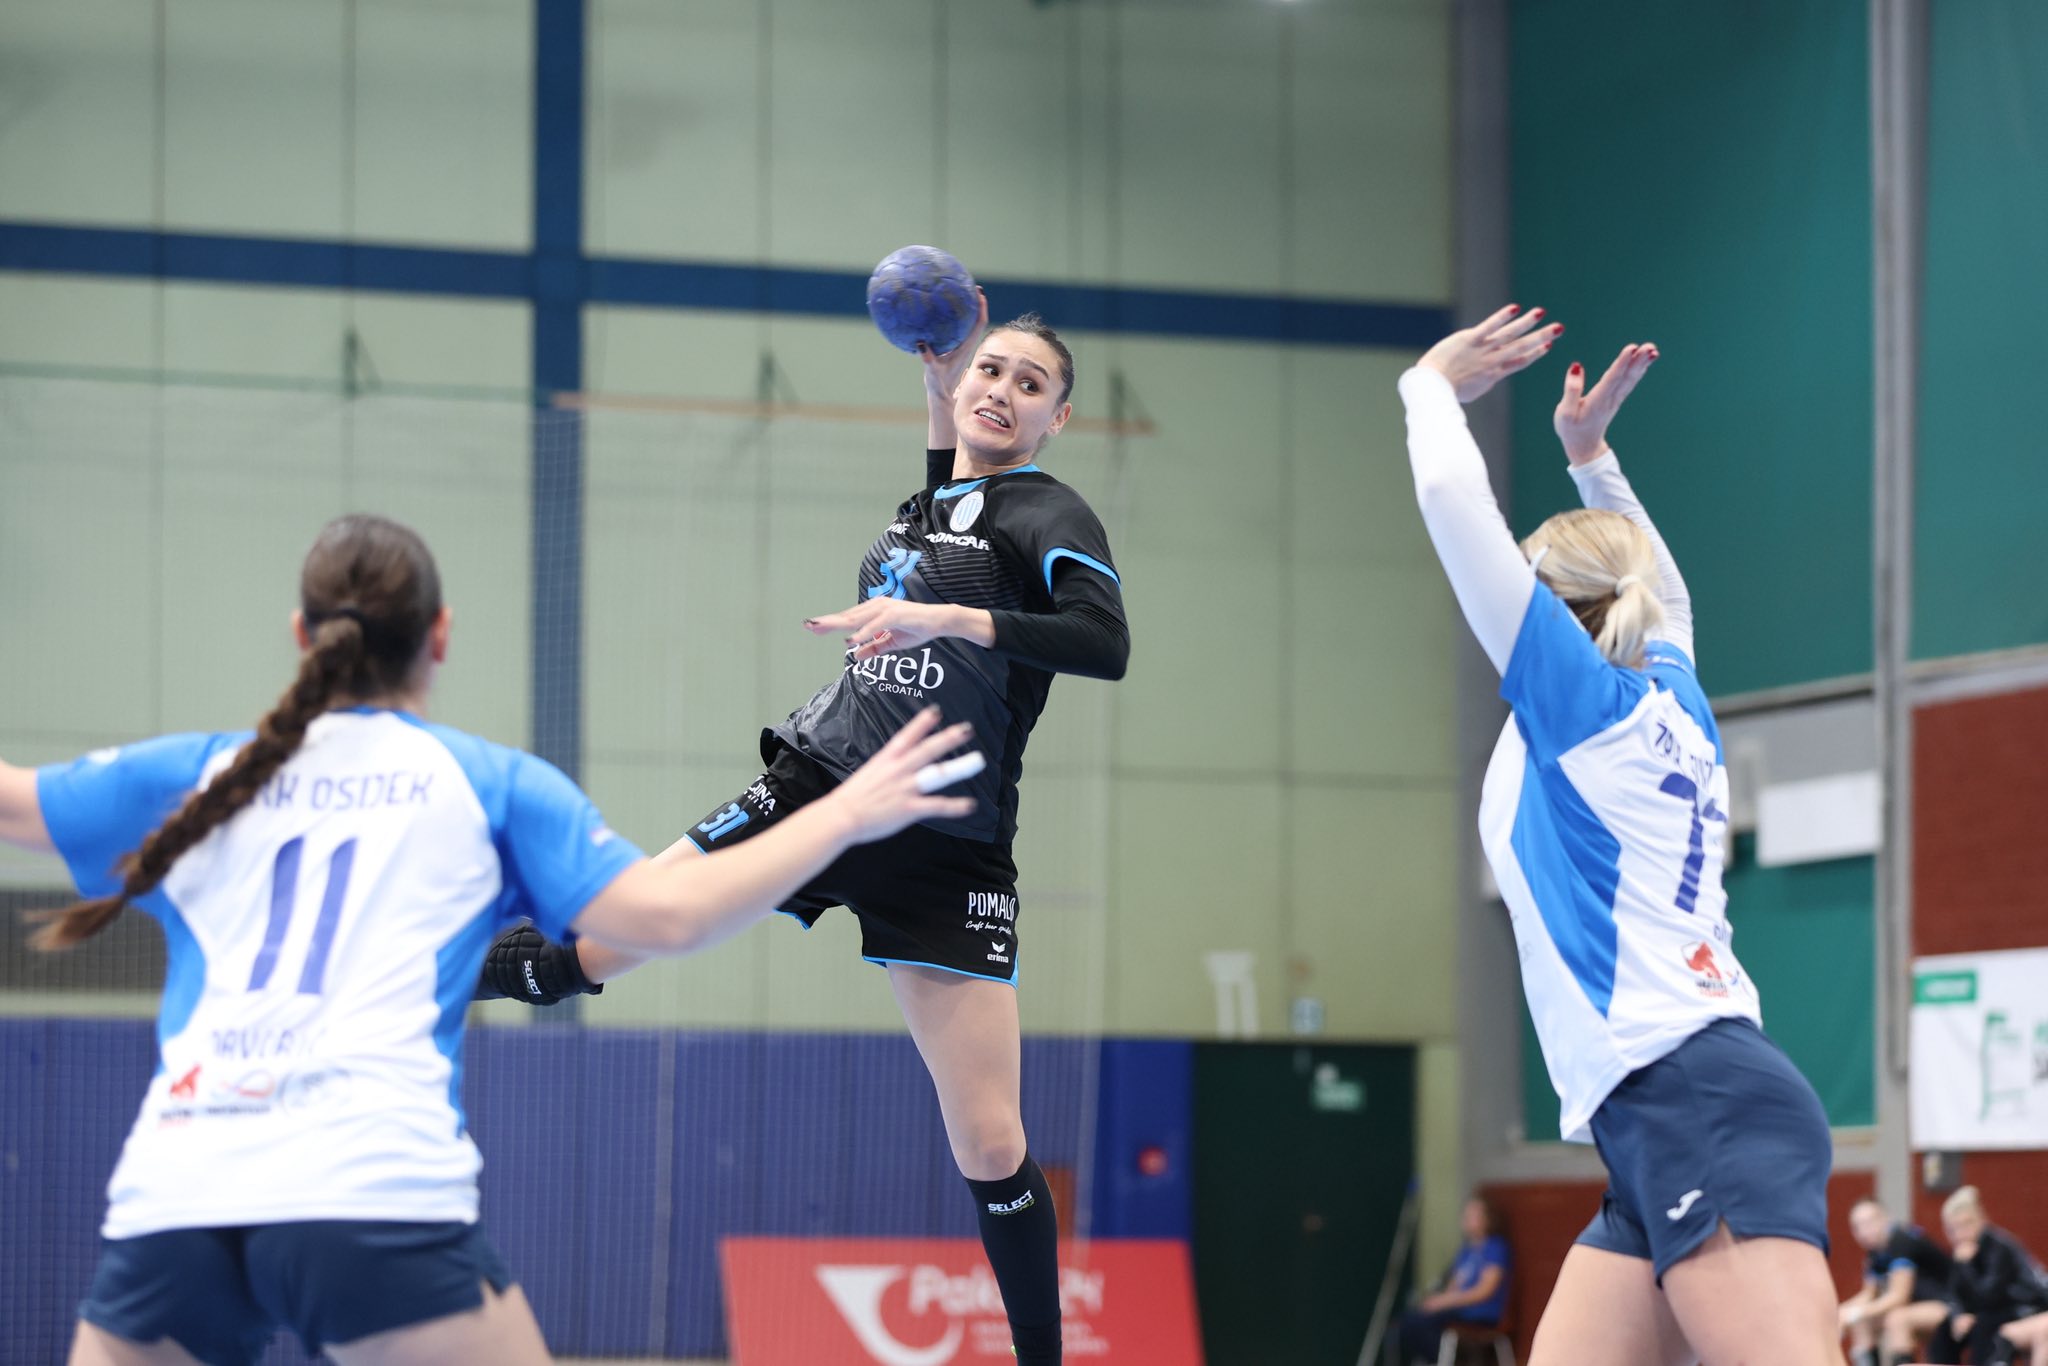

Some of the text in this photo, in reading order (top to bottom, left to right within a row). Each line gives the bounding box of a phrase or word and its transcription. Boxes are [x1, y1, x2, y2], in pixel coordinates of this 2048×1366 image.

[879, 683, 924, 699] CROATIA
[697, 802, 749, 841] 31
[246, 835, 358, 995] 11
[965, 921, 984, 931] Craft
[987, 953, 1009, 964] erima
[524, 960, 542, 995] SELECT
[988, 1190, 1033, 1212] SELECT
